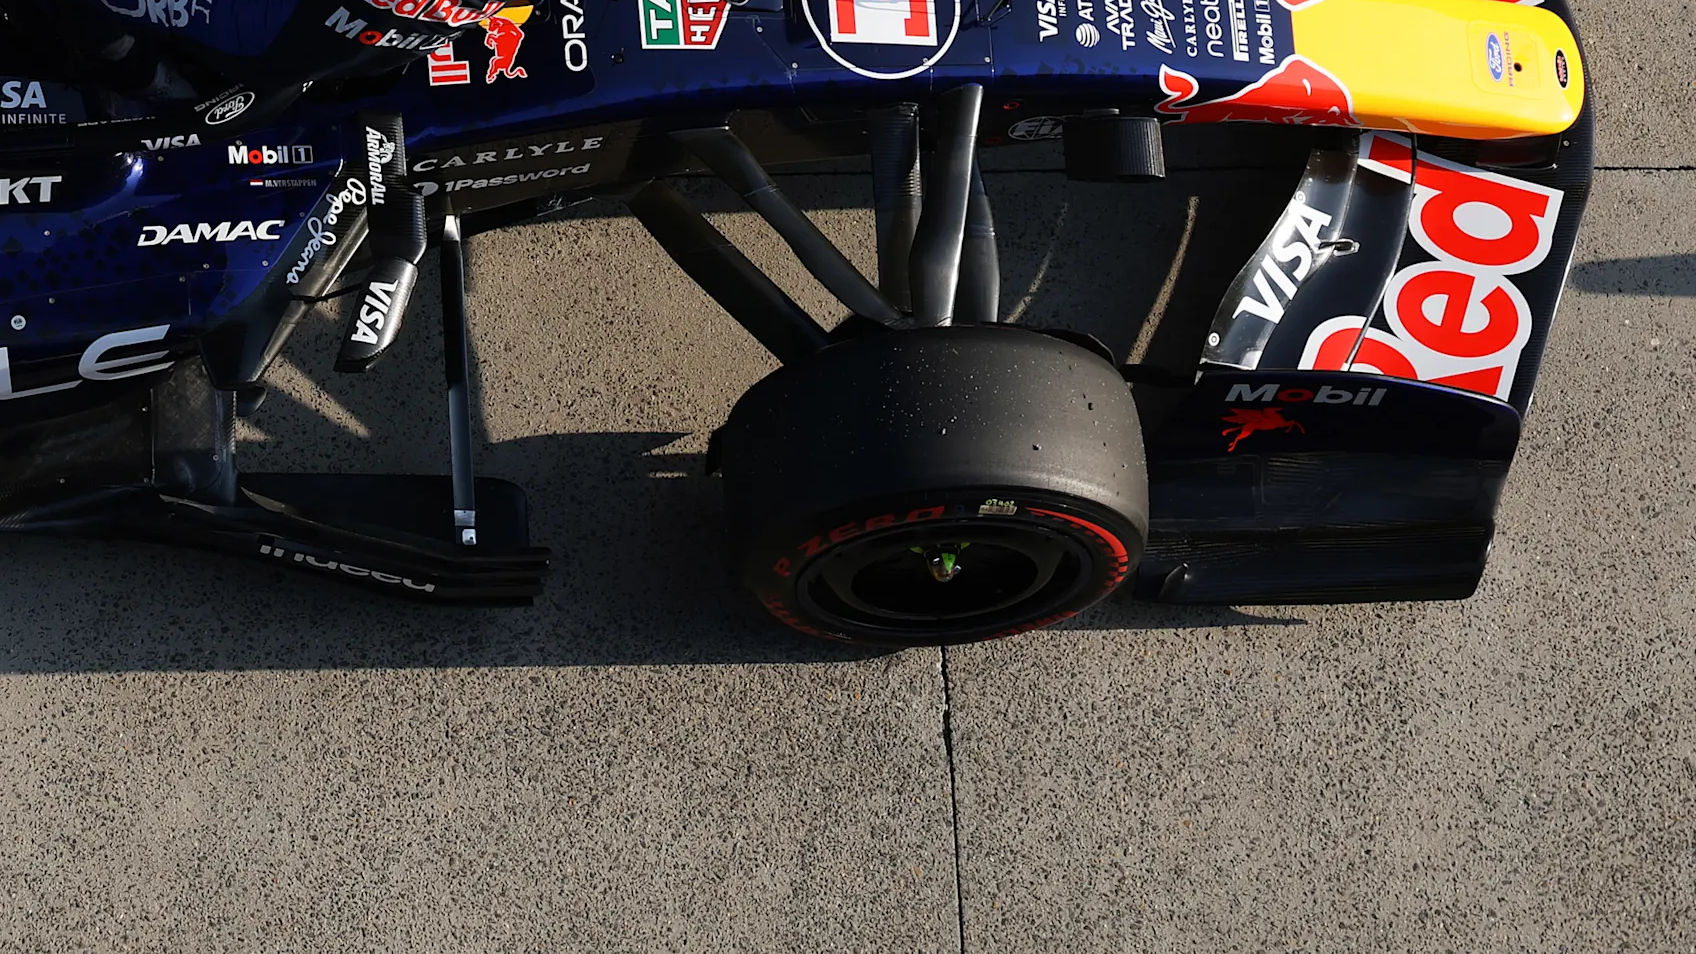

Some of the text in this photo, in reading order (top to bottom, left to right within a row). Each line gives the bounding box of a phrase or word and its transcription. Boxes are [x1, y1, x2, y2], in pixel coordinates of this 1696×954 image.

[325, 6, 428, 49] Mobil
[1257, 13, 1276, 65] Mobil
[430, 42, 469, 84] ull
[1488, 41, 1501, 73] Ford
[2, 112, 67, 125] INFINITE
[215, 96, 246, 119] Ford
[141, 134, 201, 150] VISA
[228, 145, 289, 164] Mobil
[413, 137, 603, 172] CARLYLE
[445, 163, 590, 192] 1Password
[137, 219, 285, 247] DAMAC
[286, 178, 366, 284] Pepe Jeans
[1233, 204, 1332, 325] VISA
[1312, 134, 1551, 396] Red
[351, 280, 398, 345] VISA
[1225, 383, 1387, 407] Mobil
[797, 505, 945, 558] ZERO
